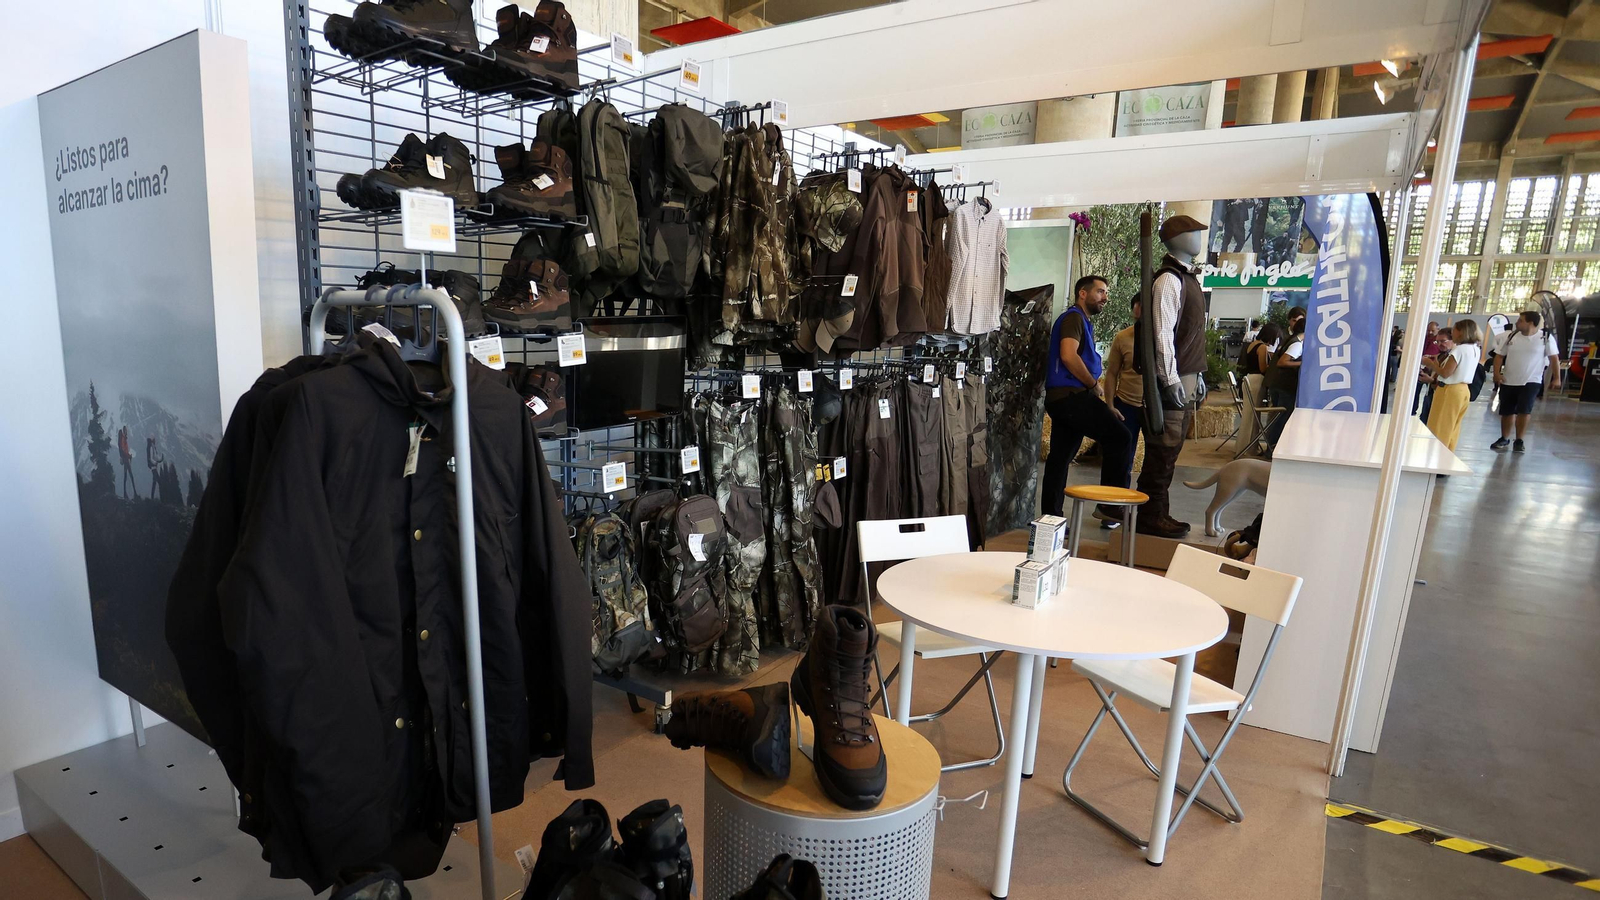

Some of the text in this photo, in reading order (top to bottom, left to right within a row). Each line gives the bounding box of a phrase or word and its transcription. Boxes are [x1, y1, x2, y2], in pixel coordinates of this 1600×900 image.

[1166, 95, 1204, 112] CAZA
[55, 136, 129, 182] ¿Listos para
[58, 164, 169, 214] alcanzar la cima?
[1202, 260, 1238, 278] orte
